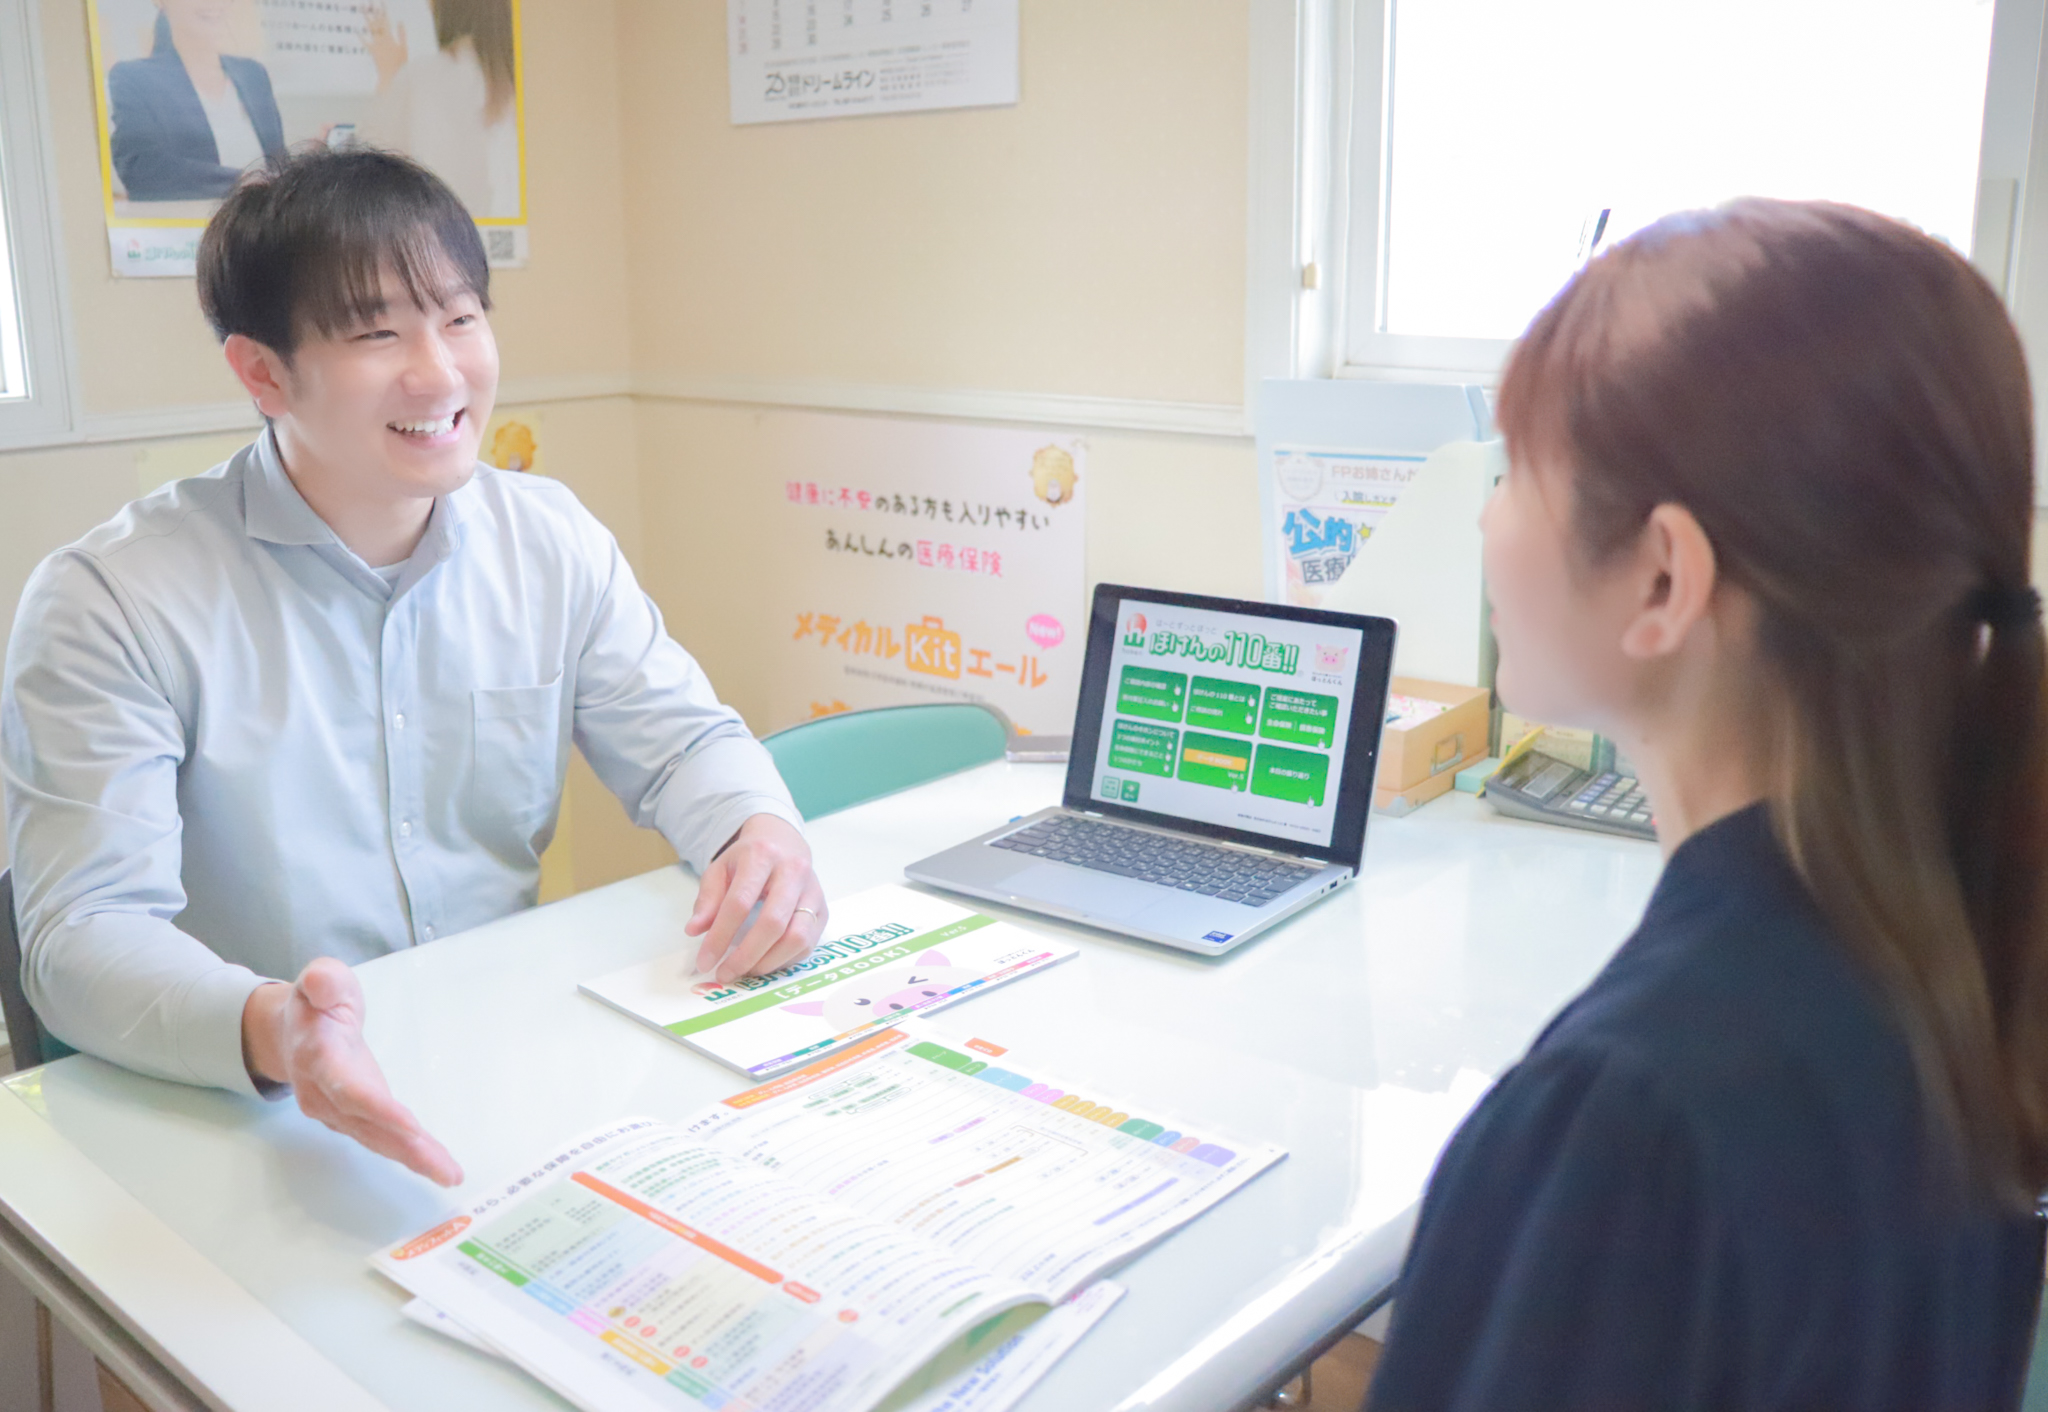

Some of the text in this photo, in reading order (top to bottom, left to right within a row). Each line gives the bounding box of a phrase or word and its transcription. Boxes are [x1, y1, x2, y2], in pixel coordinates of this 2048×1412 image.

[786, 482, 1049, 530] 健康に不安のある方も入りやすい
[826, 529, 1003, 578] あんしんの医療保険
[1282, 507, 1353, 555] 公的
[1302, 554, 1354, 584] 医療
[1149, 630, 1300, 675] ほけんの110番!!
